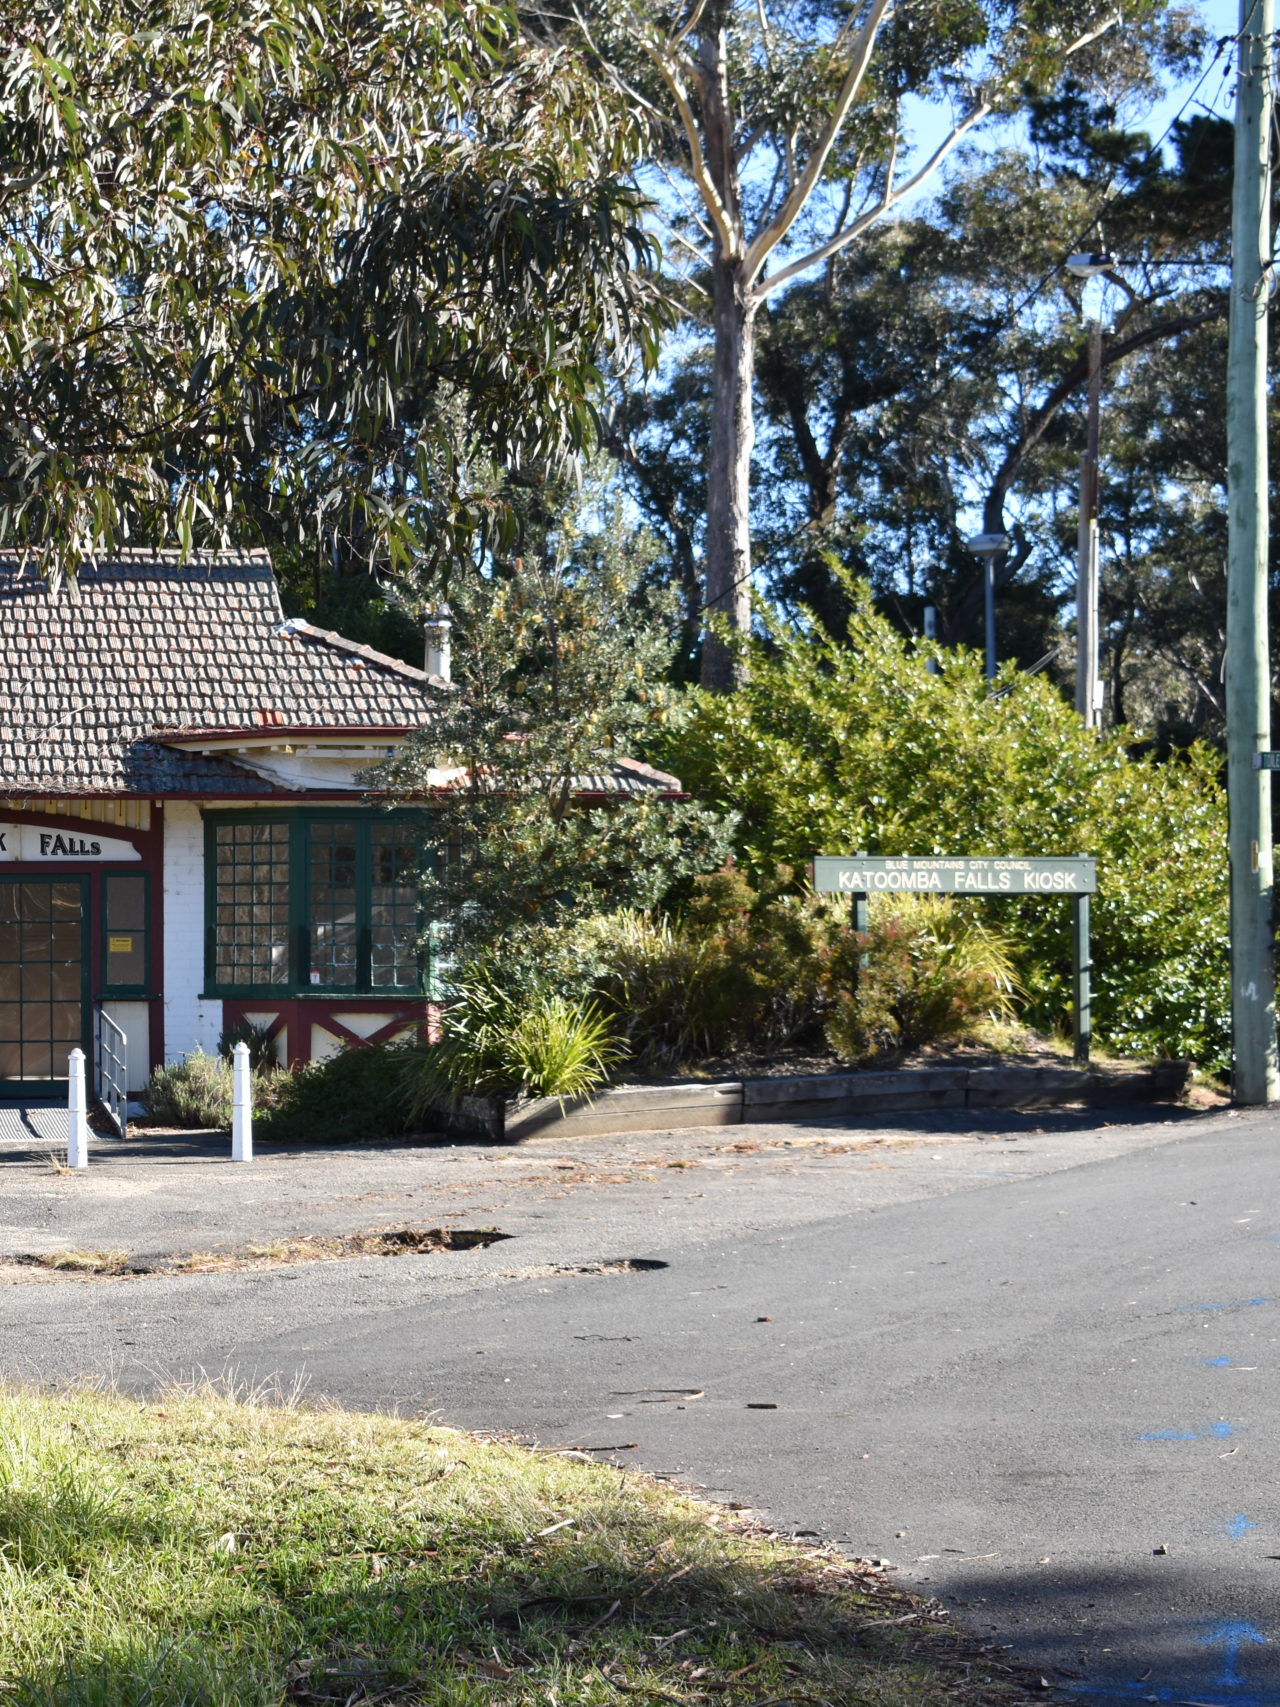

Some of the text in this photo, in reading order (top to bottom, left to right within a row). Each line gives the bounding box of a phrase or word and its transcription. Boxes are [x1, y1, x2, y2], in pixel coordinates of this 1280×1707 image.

[39, 833, 102, 856] FALLS
[885, 860, 1032, 871] BLUE MOUNTAINS CITY COUNCIL
[838, 871, 1077, 889] KATOOMBA FALLS KIOSK
